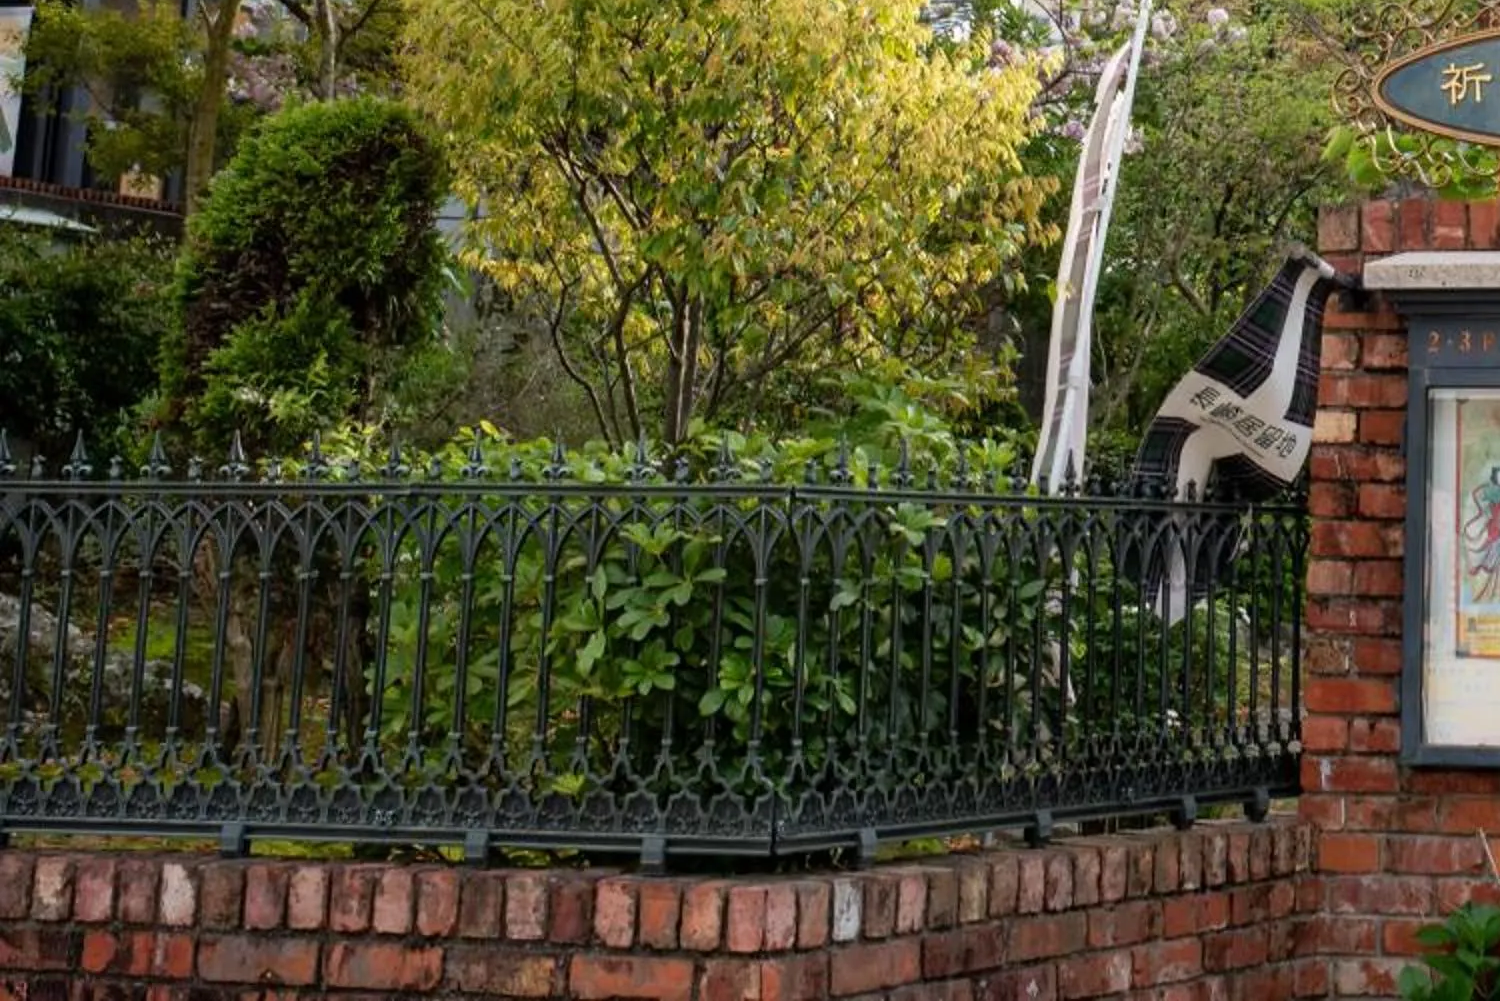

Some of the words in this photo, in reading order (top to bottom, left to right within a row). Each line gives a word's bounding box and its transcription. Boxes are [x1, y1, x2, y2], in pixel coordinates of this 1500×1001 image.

[1189, 385, 1298, 459] 長崎居留地
